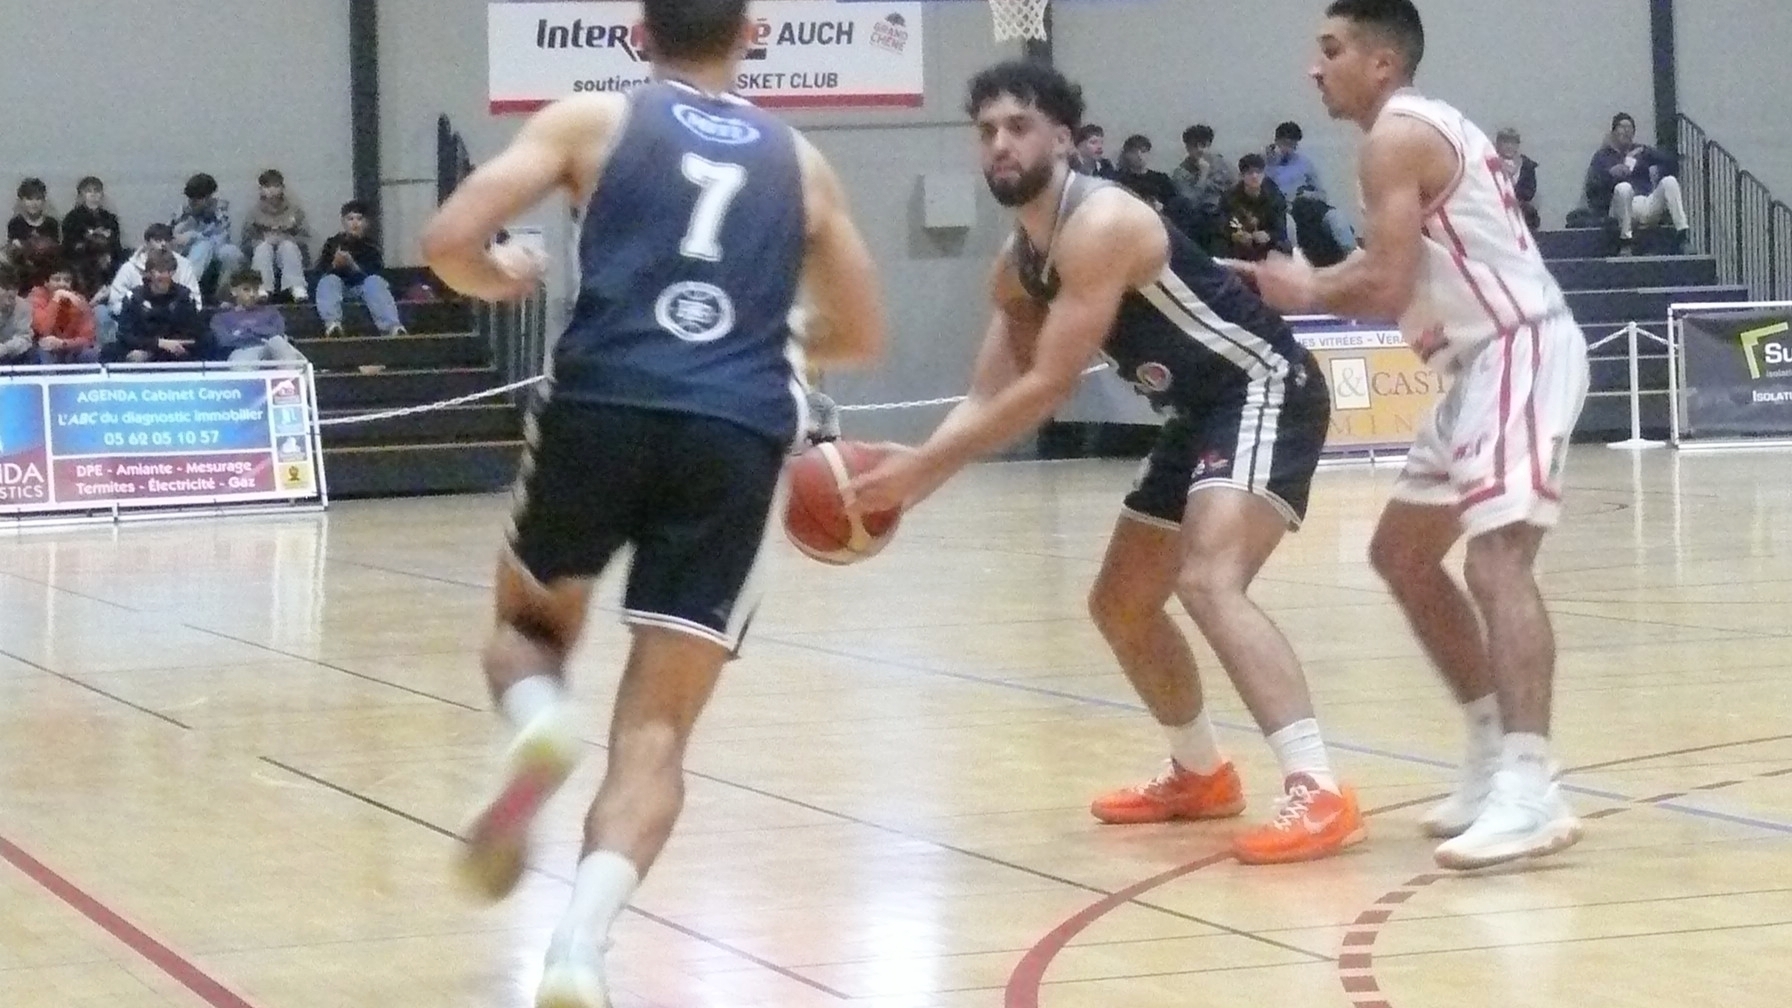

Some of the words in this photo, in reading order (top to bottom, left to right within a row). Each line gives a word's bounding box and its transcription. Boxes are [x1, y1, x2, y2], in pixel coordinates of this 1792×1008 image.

[776, 21, 855, 46] AUCH
[737, 73, 786, 89] SKET
[789, 72, 839, 88] CLUB
[679, 152, 748, 262] 7
[1319, 335, 1364, 347] VITRÉES
[76, 388, 138, 403] AGENDA
[141, 388, 195, 402] Cabinet
[198, 387, 242, 402] Cayon
[57, 412, 98, 426] L'ABC
[99, 411, 119, 424] du
[121, 410, 192, 426] diagnostic
[103, 432, 125, 446] 05
[128, 432, 149, 446] 62
[151, 432, 172, 445] 05
[177, 430, 197, 445] 10
[199, 430, 220, 444] 57
[0, 462, 45, 485] DA
[76, 464, 103, 477] DPE
[116, 463, 173, 476] Amiante
[185, 461, 252, 474] Mesurage
[75, 481, 136, 495] Termites
[228, 476, 255, 488] Gaz
